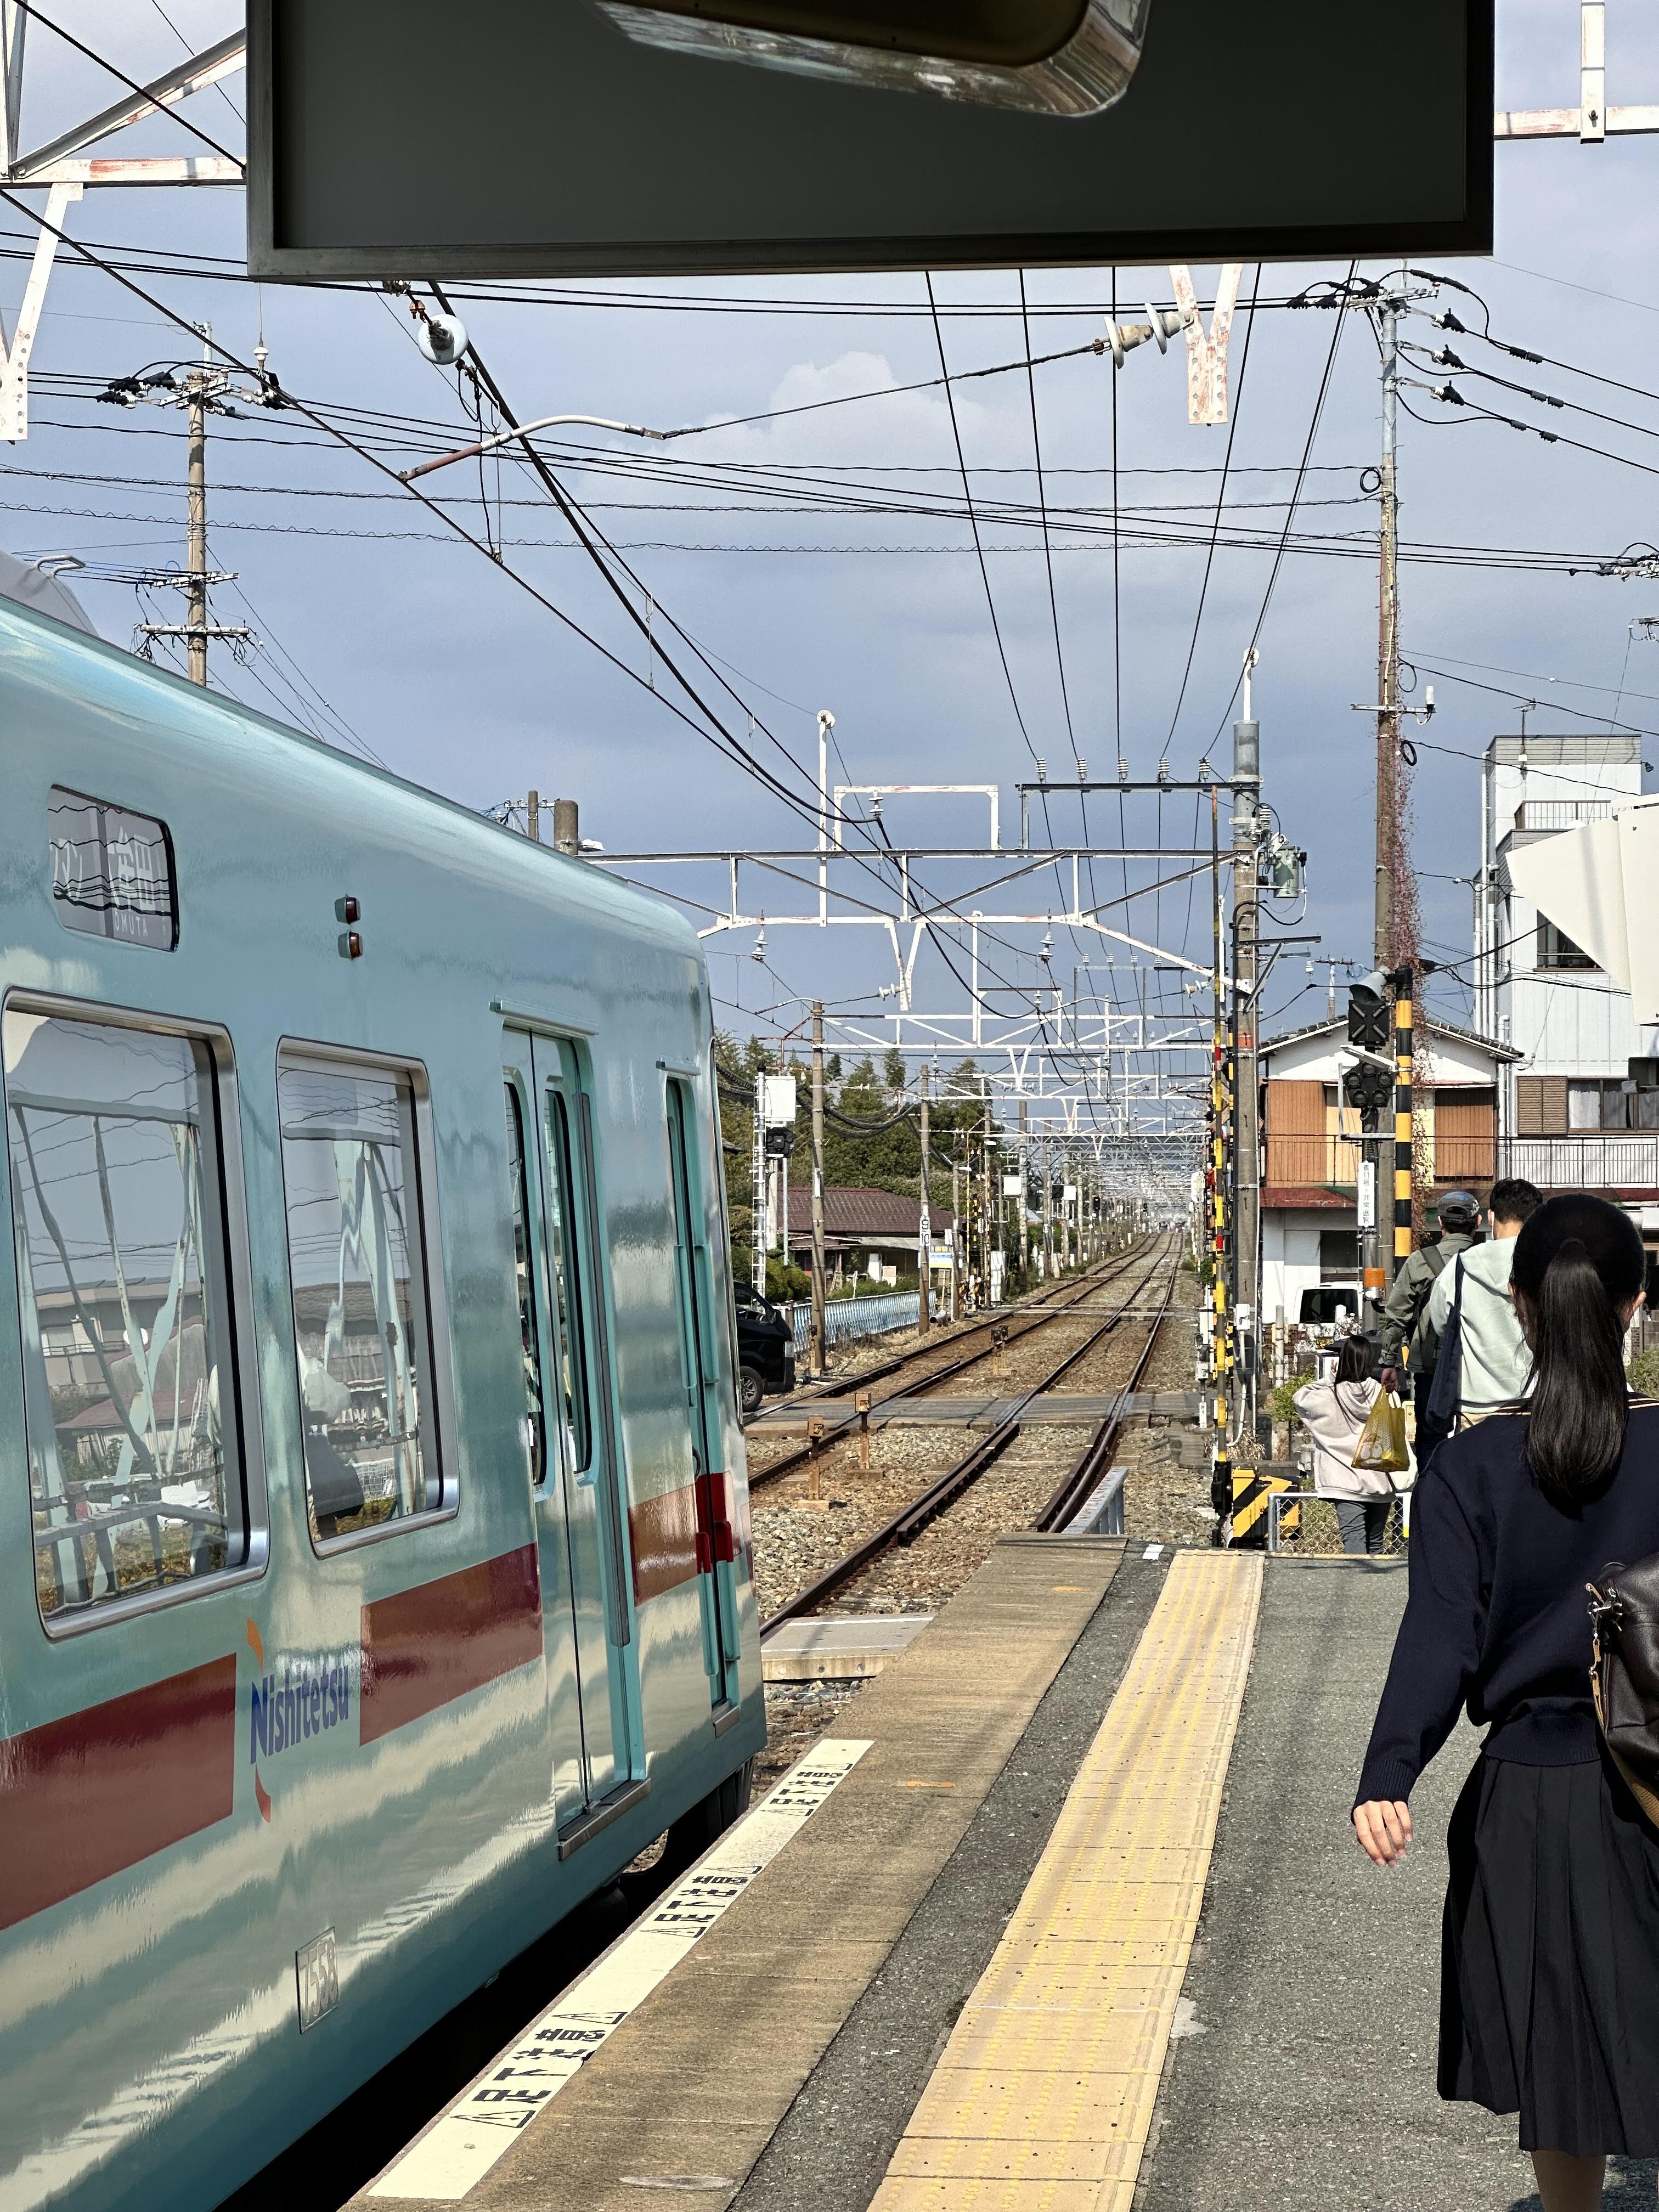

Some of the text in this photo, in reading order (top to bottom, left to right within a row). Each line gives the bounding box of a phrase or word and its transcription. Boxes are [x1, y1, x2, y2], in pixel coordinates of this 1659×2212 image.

[251, 1664, 349, 1764] Nishitetsu
[770, 1771, 844, 1806] 足下注意
[653, 1876, 749, 1923] 足下注意
[471, 2029, 606, 2104] 足下注意
